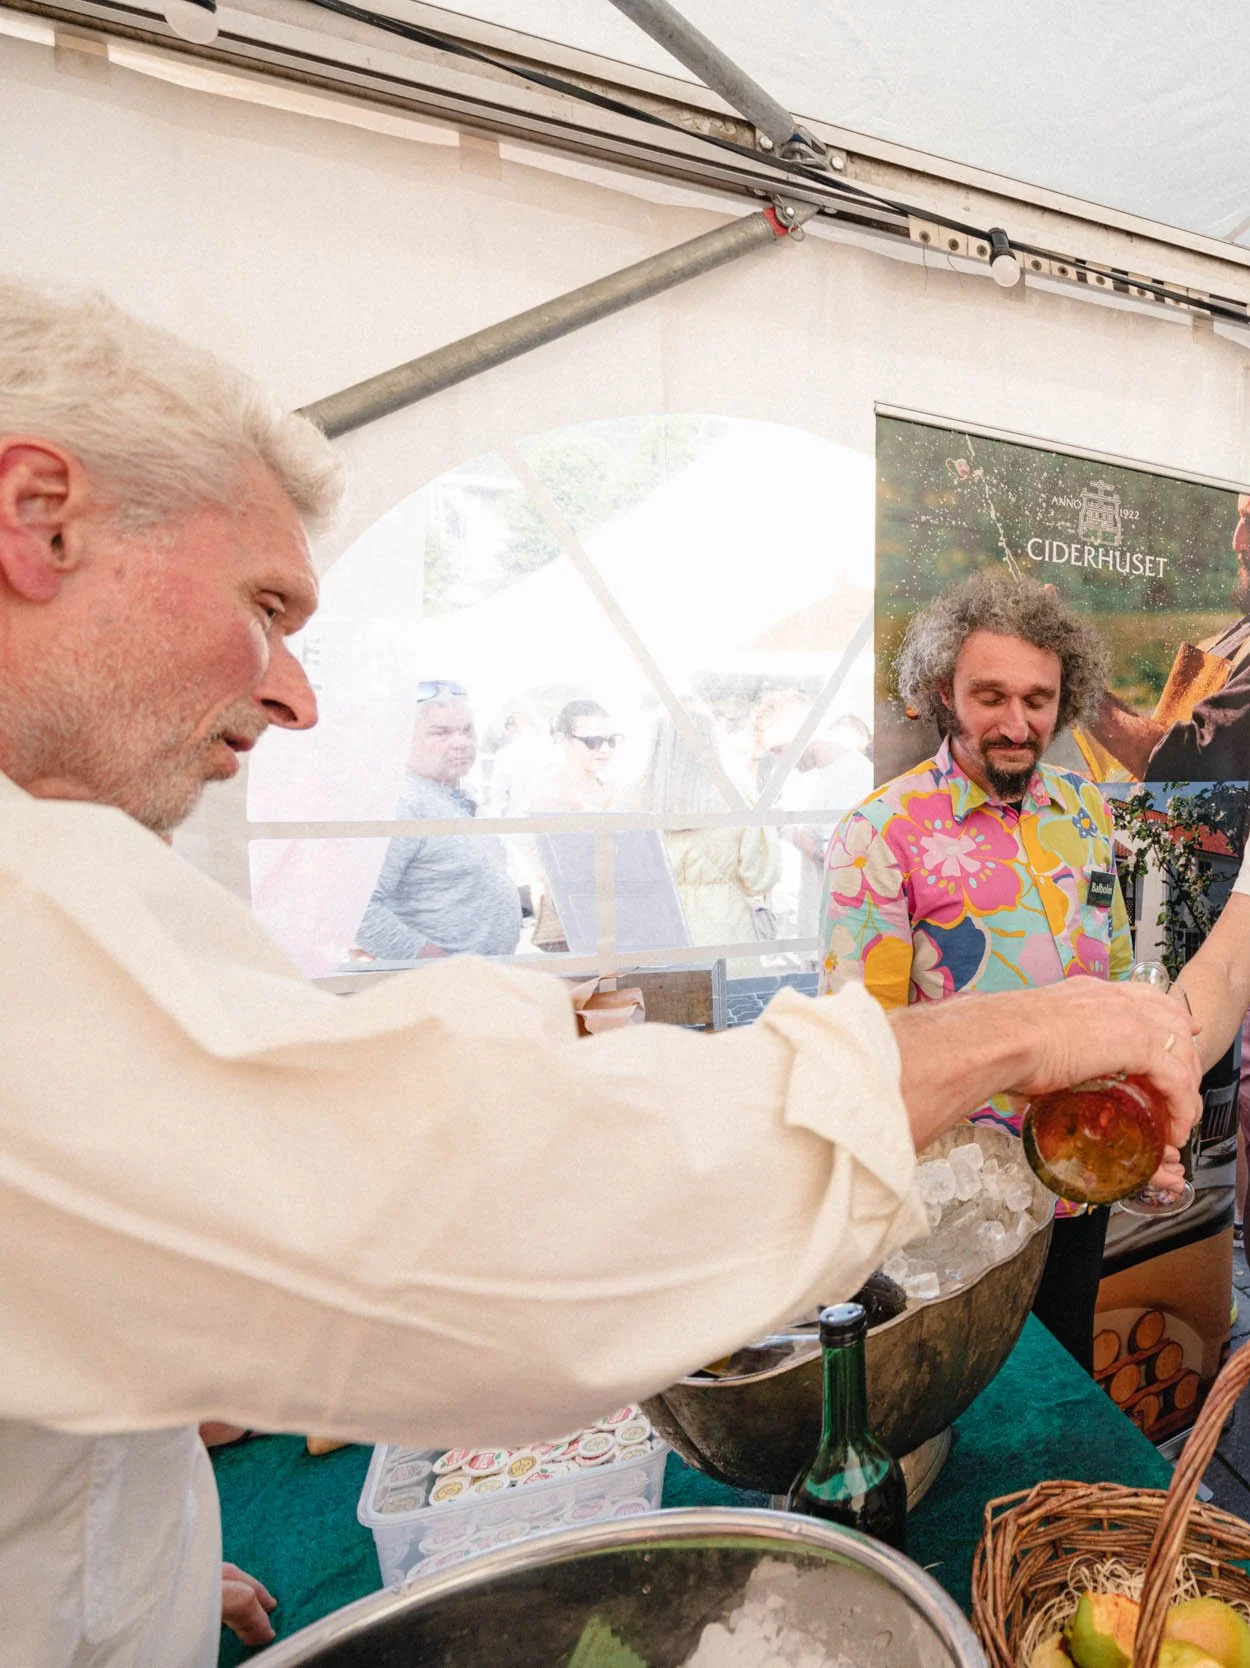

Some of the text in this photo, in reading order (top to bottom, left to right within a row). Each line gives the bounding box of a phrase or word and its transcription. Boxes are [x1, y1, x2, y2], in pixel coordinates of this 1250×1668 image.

[1051, 495, 1140, 520] ANNO 1922
[1027, 537, 1168, 578] CIDERHUSET
